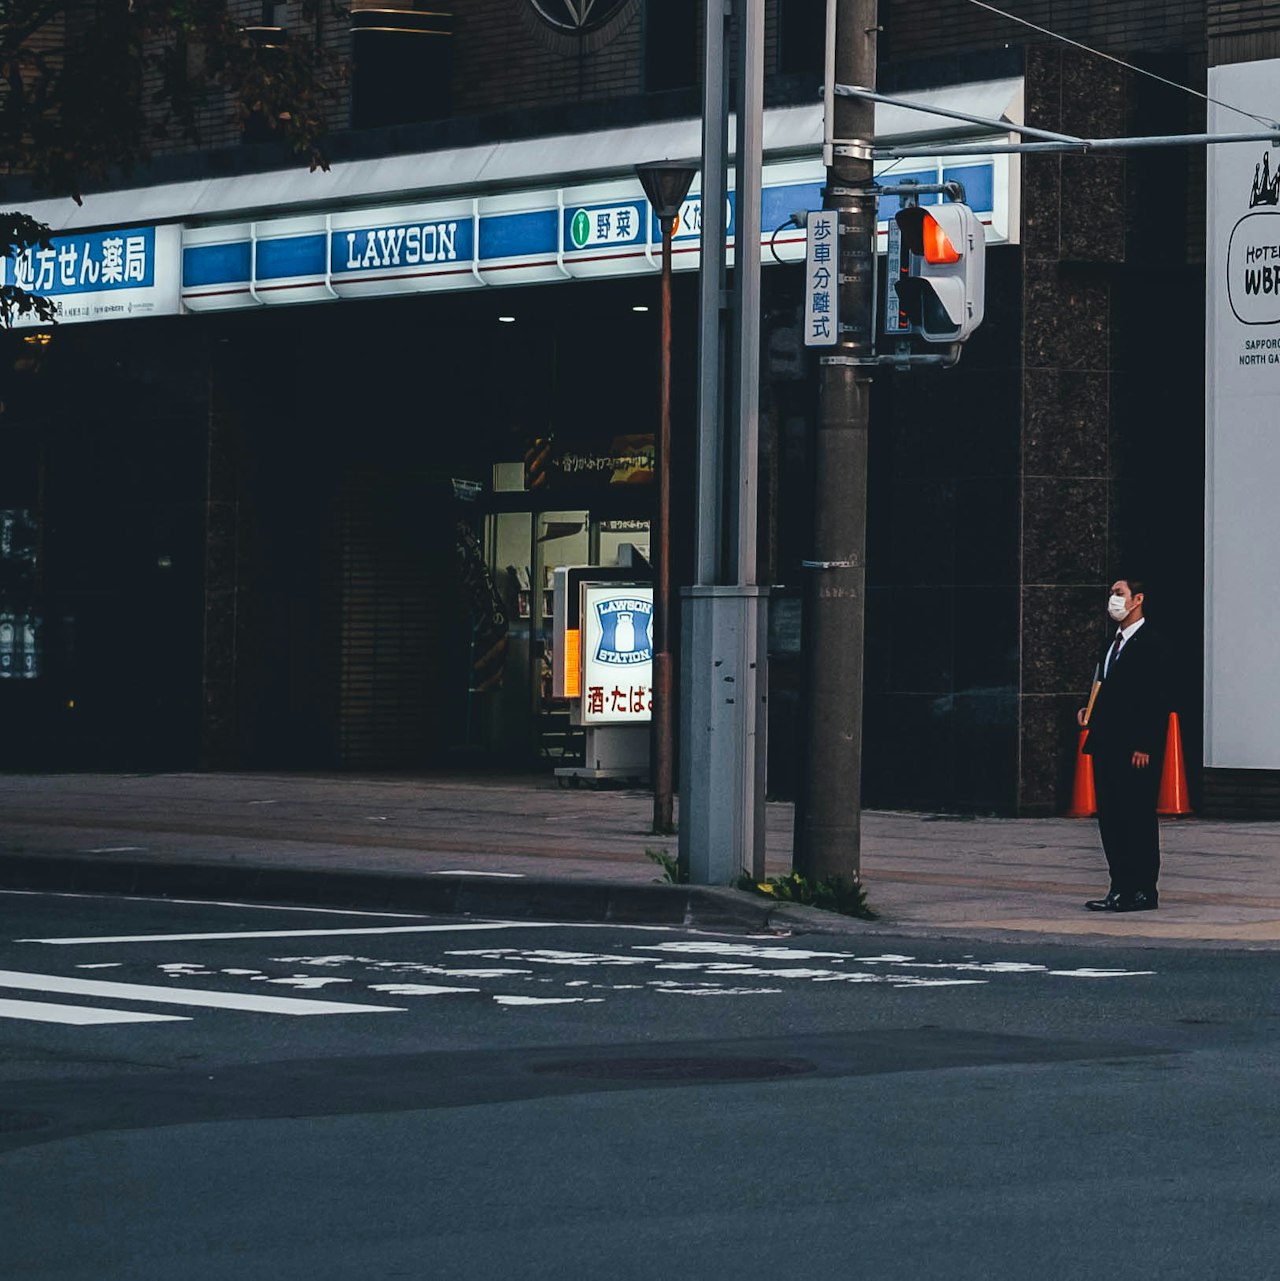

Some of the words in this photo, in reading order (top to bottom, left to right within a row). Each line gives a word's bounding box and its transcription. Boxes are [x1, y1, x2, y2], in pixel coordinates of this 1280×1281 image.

[596, 210, 633, 240] 野菜
[346, 222, 458, 269] LAWSON
[14, 235, 146, 291] 処方せん薬局
[812, 219, 831, 338] 歩車分離式
[1239, 354, 1266, 366] NORTH
[599, 600, 652, 615] LAWSON
[599, 648, 651, 663] STATION
